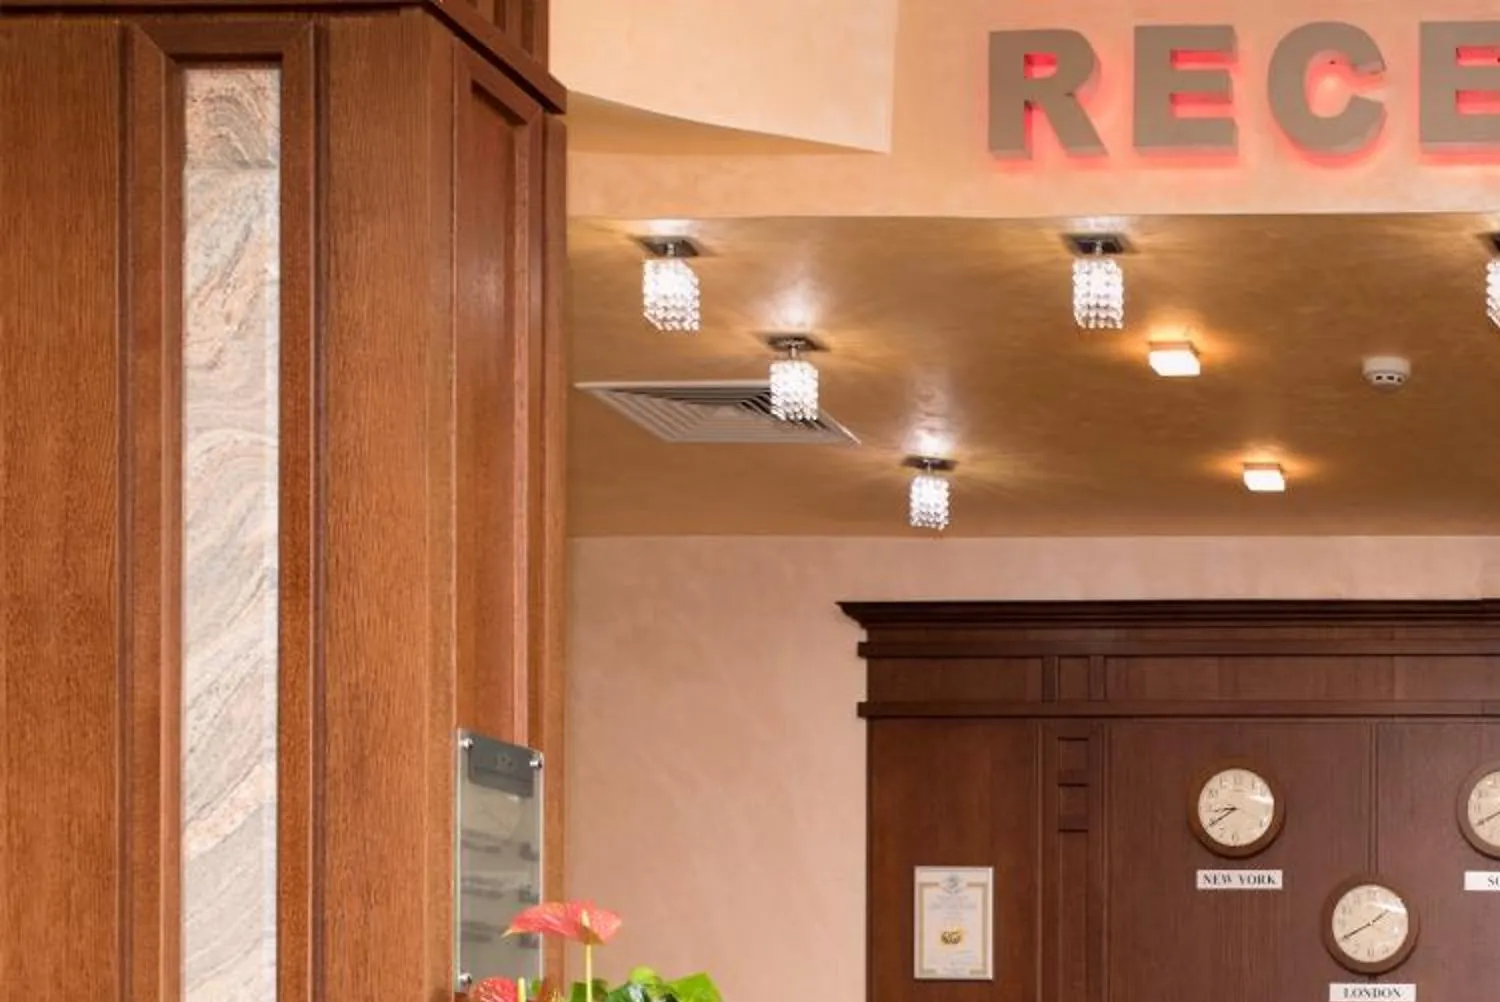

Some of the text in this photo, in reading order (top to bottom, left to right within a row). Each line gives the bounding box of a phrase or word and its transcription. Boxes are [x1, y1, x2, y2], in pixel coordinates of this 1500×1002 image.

[1202, 873, 1278, 886] NEW YORK
[1342, 986, 1403, 999] LONDON
